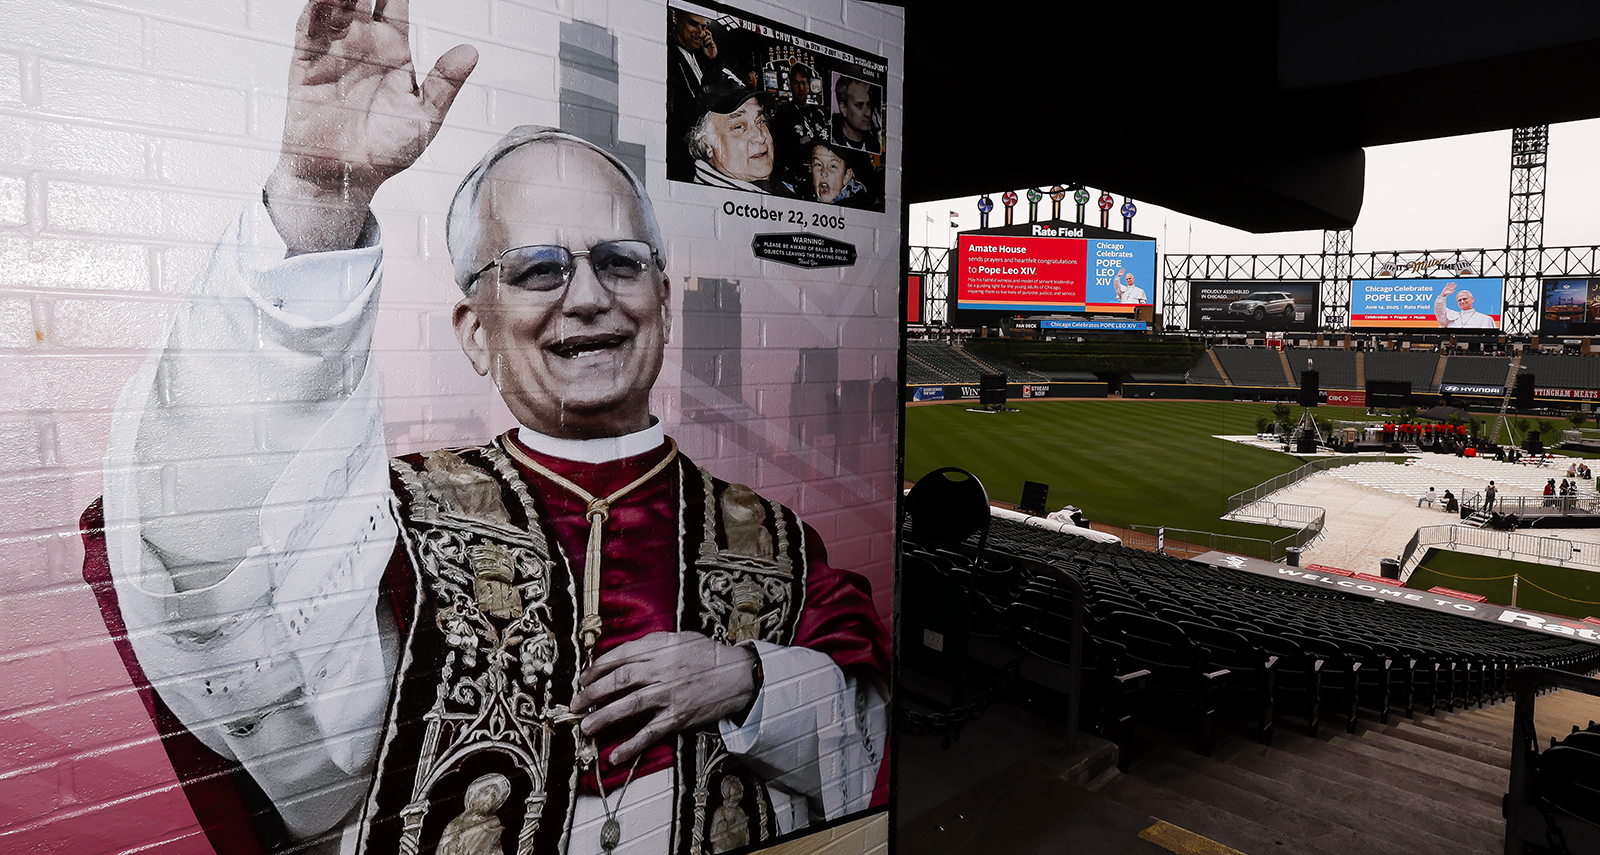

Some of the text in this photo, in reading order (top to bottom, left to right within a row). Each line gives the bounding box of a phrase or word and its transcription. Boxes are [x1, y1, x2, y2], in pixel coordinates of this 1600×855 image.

[743, 20, 757, 32] HOU
[763, 27, 768, 35] 3
[775, 31, 791, 43] CHW
[723, 201, 845, 230] October 22, 2005
[1032, 224, 1084, 238] Rate Field
[763, 241, 781, 249] PLEASE
[792, 236, 825, 246] WARNING!
[968, 244, 1027, 254] Amate House
[1096, 242, 1124, 251] Chicago
[1096, 250, 1134, 258] Celebrates
[1096, 259, 1122, 268] POPE
[1406, 258, 1446, 274] Miller
[968, 265, 978, 274] to
[978, 265, 1002, 276] Pope
[1002, 266, 1019, 275] Leo
[1096, 268, 1115, 277] LEO
[1095, 277, 1112, 286] XIV
[1365, 285, 1393, 293] Chicago
[1365, 293, 1433, 302] POPE LEO XIV
[1460, 386, 1500, 394] HYUNDAI
[1573, 390, 1599, 399] MEATS
[1278, 568, 1477, 612] WELCOME TO
